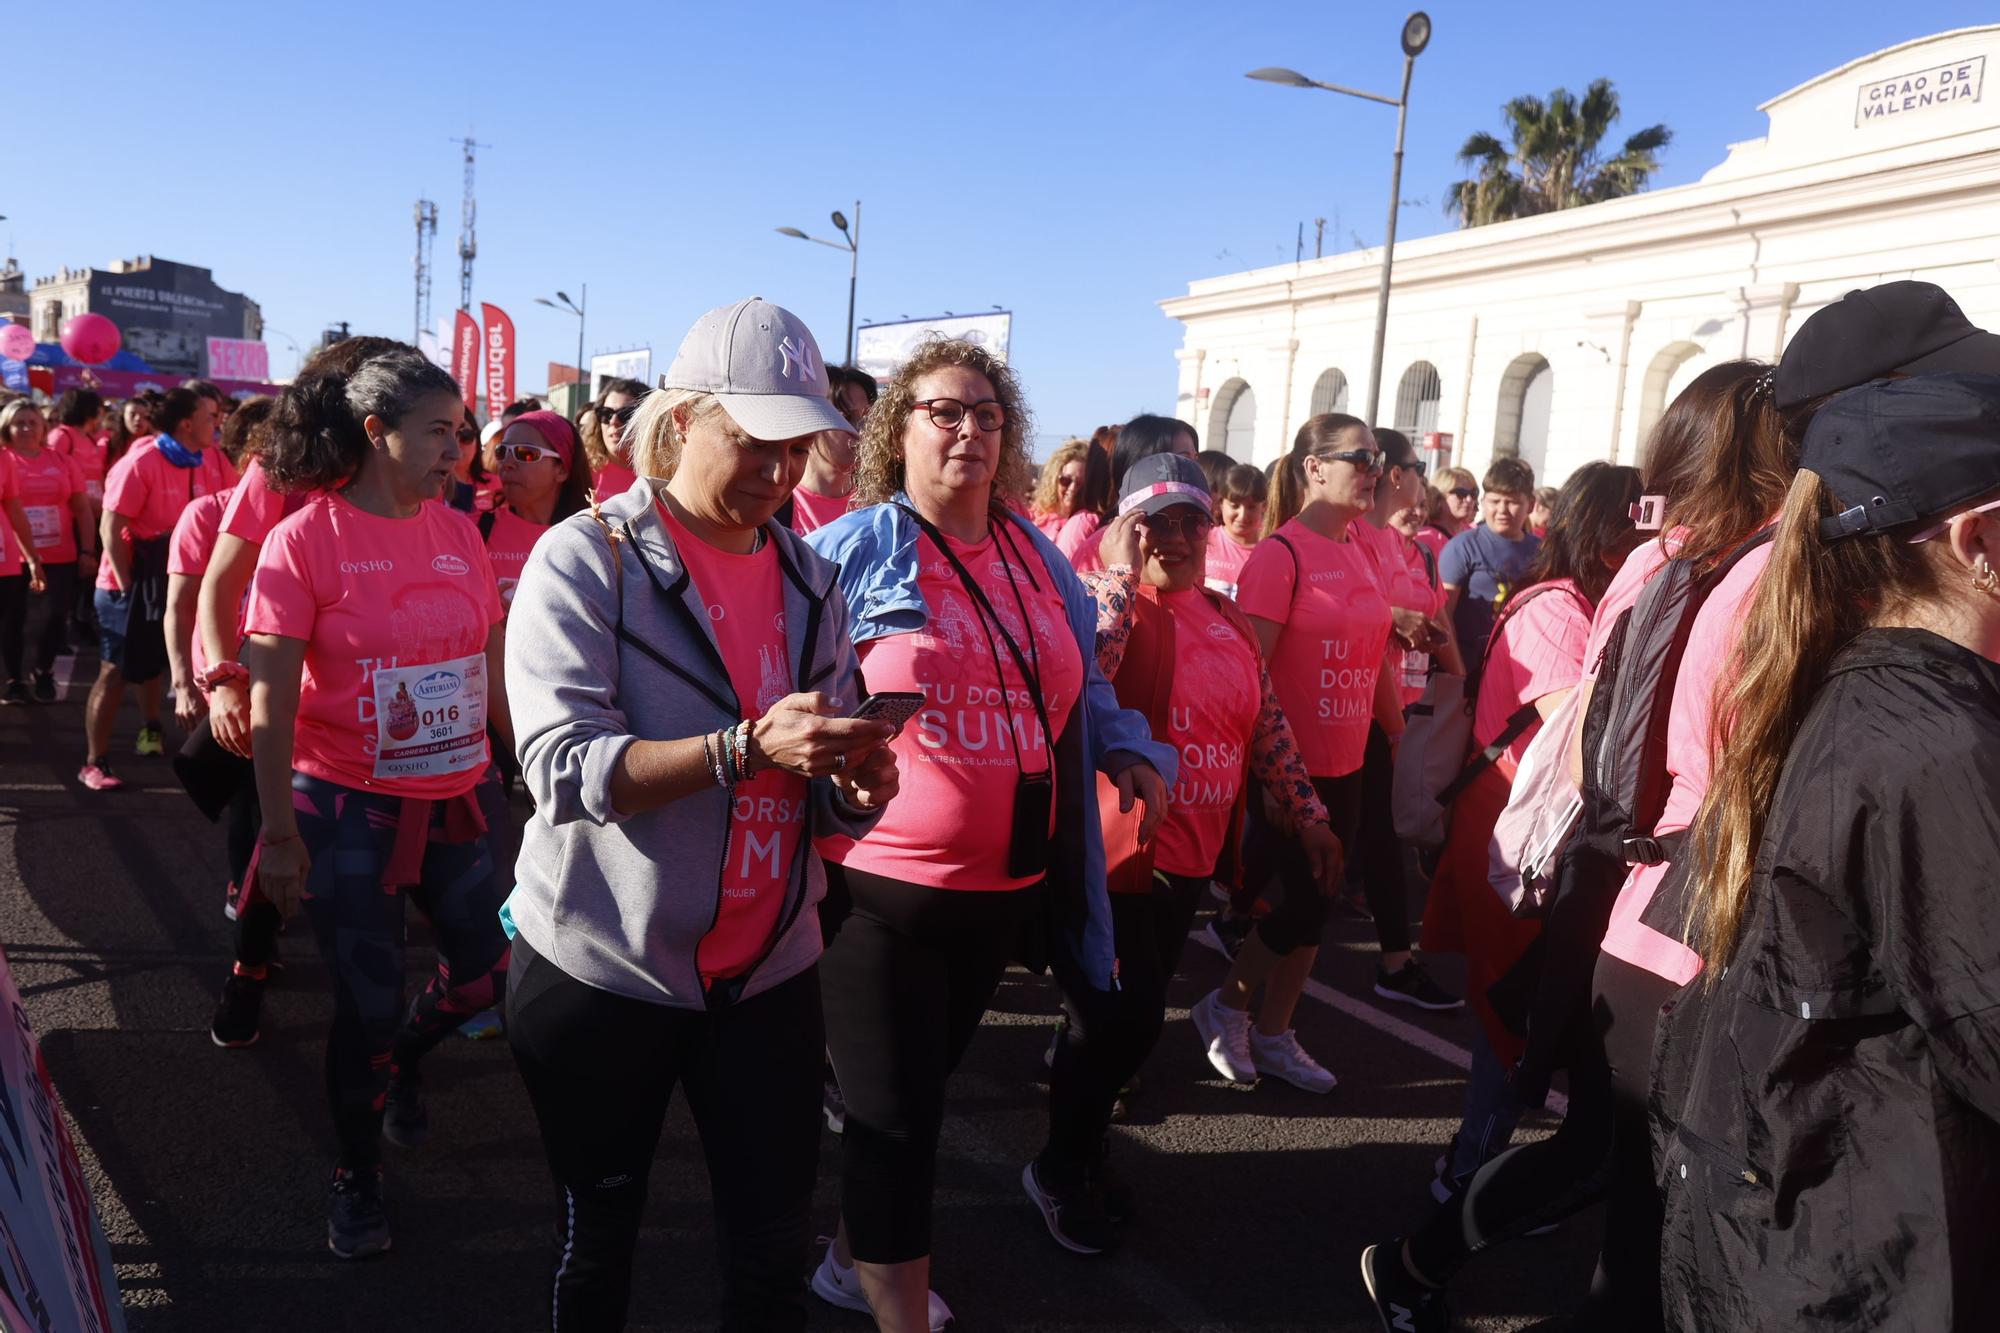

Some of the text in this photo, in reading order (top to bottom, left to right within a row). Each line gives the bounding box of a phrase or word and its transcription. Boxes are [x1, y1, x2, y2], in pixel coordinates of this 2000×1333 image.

[1869, 65, 1972, 101] GRAO DE
[1863, 83, 1972, 120] VALENCIA
[115, 286, 156, 302] PUERTO
[778, 336, 817, 382] NY
[340, 559, 393, 574] OYSHO
[488, 551, 530, 561] OYSHO
[1309, 569, 1346, 583] OYSHO
[1321, 640, 1349, 660] TU
[1320, 669, 1376, 690] DORSA
[916, 682, 955, 705] TU
[358, 696, 379, 723] D
[422, 704, 460, 727] 016
[1317, 697, 1368, 719] SUMA
[917, 709, 1048, 751] SUMA
[1172, 706, 1191, 733] U
[430, 725, 453, 740] 3601
[393, 746, 429, 758] CARRERA
[429, 744, 440, 752] DE
[440, 742, 449, 751] LA
[918, 752, 1017, 767] CARRERA DE LA MUJER
[1183, 743, 1245, 769] ORSA
[388, 760, 429, 773] OYSHO
[733, 795, 806, 823] ORSA
[723, 888, 756, 898] MUJER
